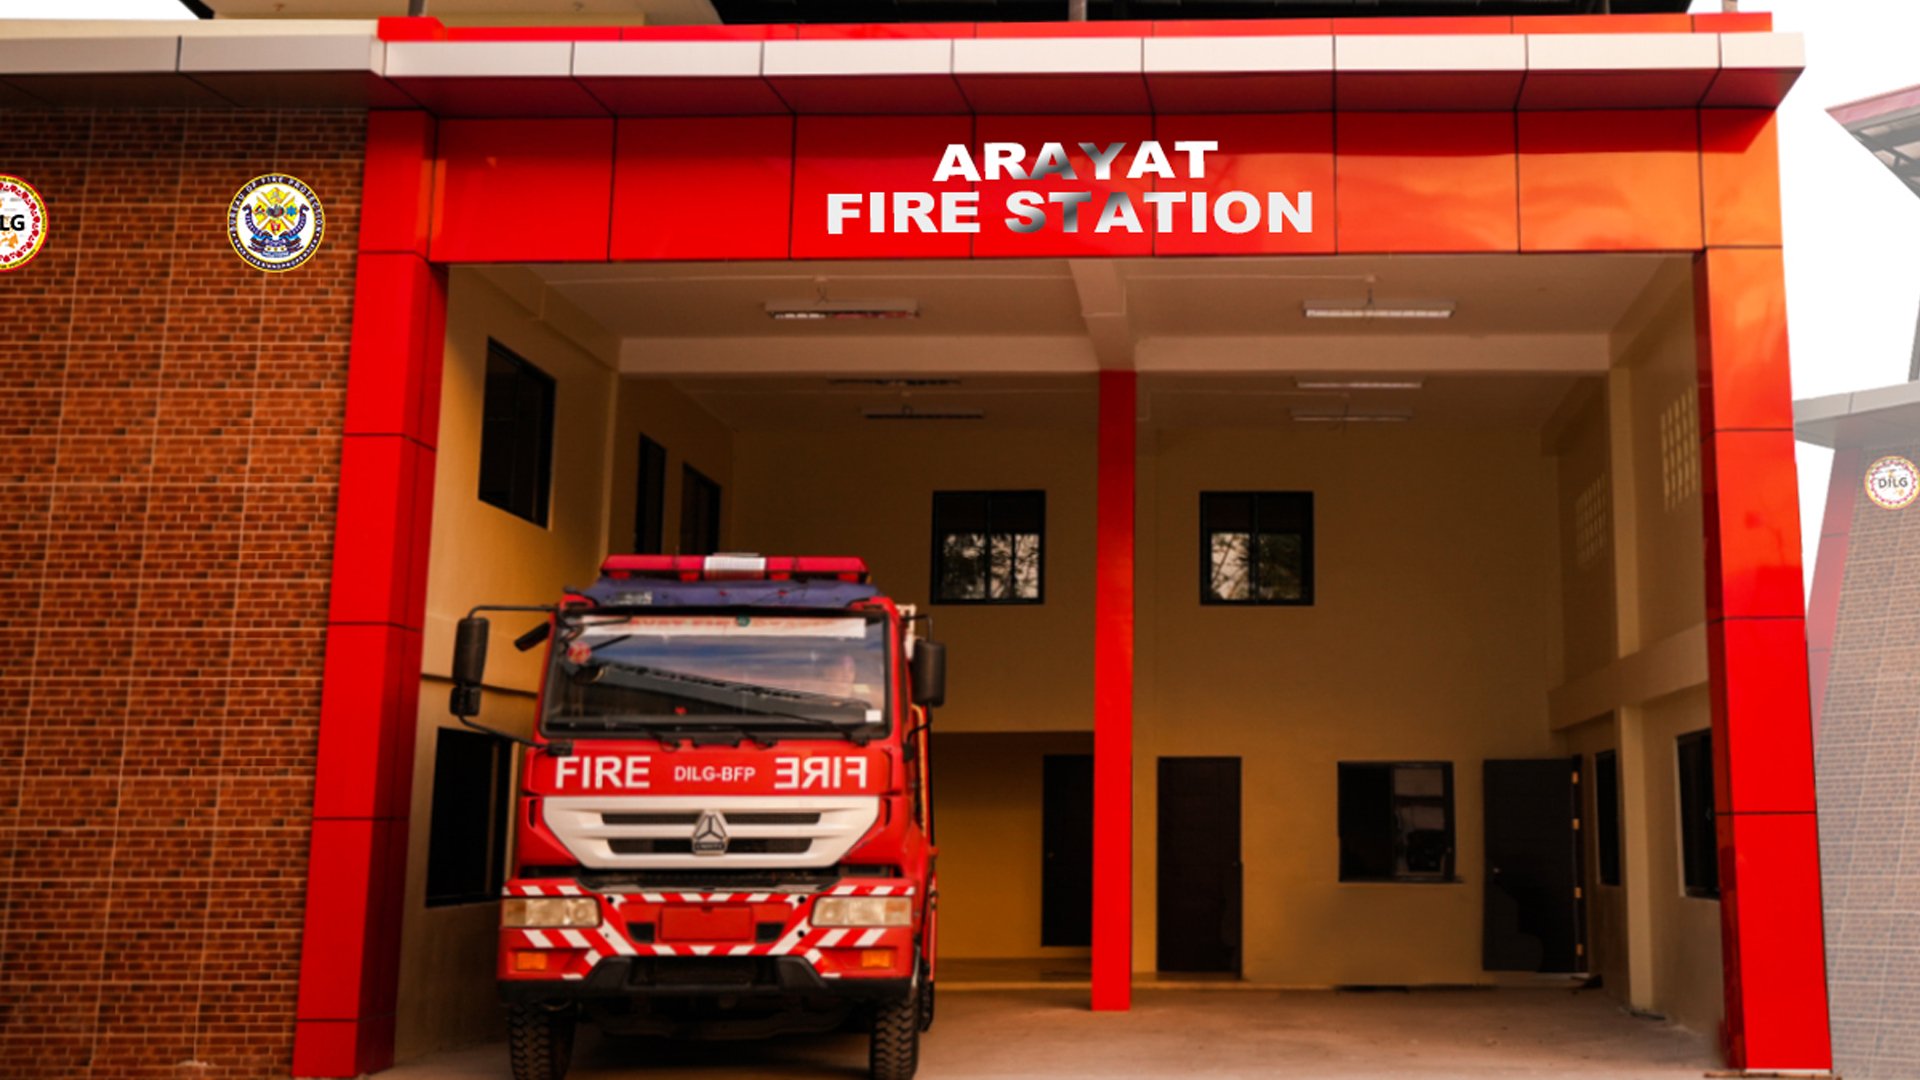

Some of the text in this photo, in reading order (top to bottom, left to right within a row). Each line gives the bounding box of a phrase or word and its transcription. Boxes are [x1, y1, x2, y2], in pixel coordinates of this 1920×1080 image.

[932, 140, 1218, 182] ARAYAT
[261, 176, 284, 185] FIRE
[827, 191, 1313, 235] FIRE STATION
[1878, 477, 1908, 488] DILG
[555, 756, 651, 789] FIRE
[673, 765, 756, 782] DILG-BFP
